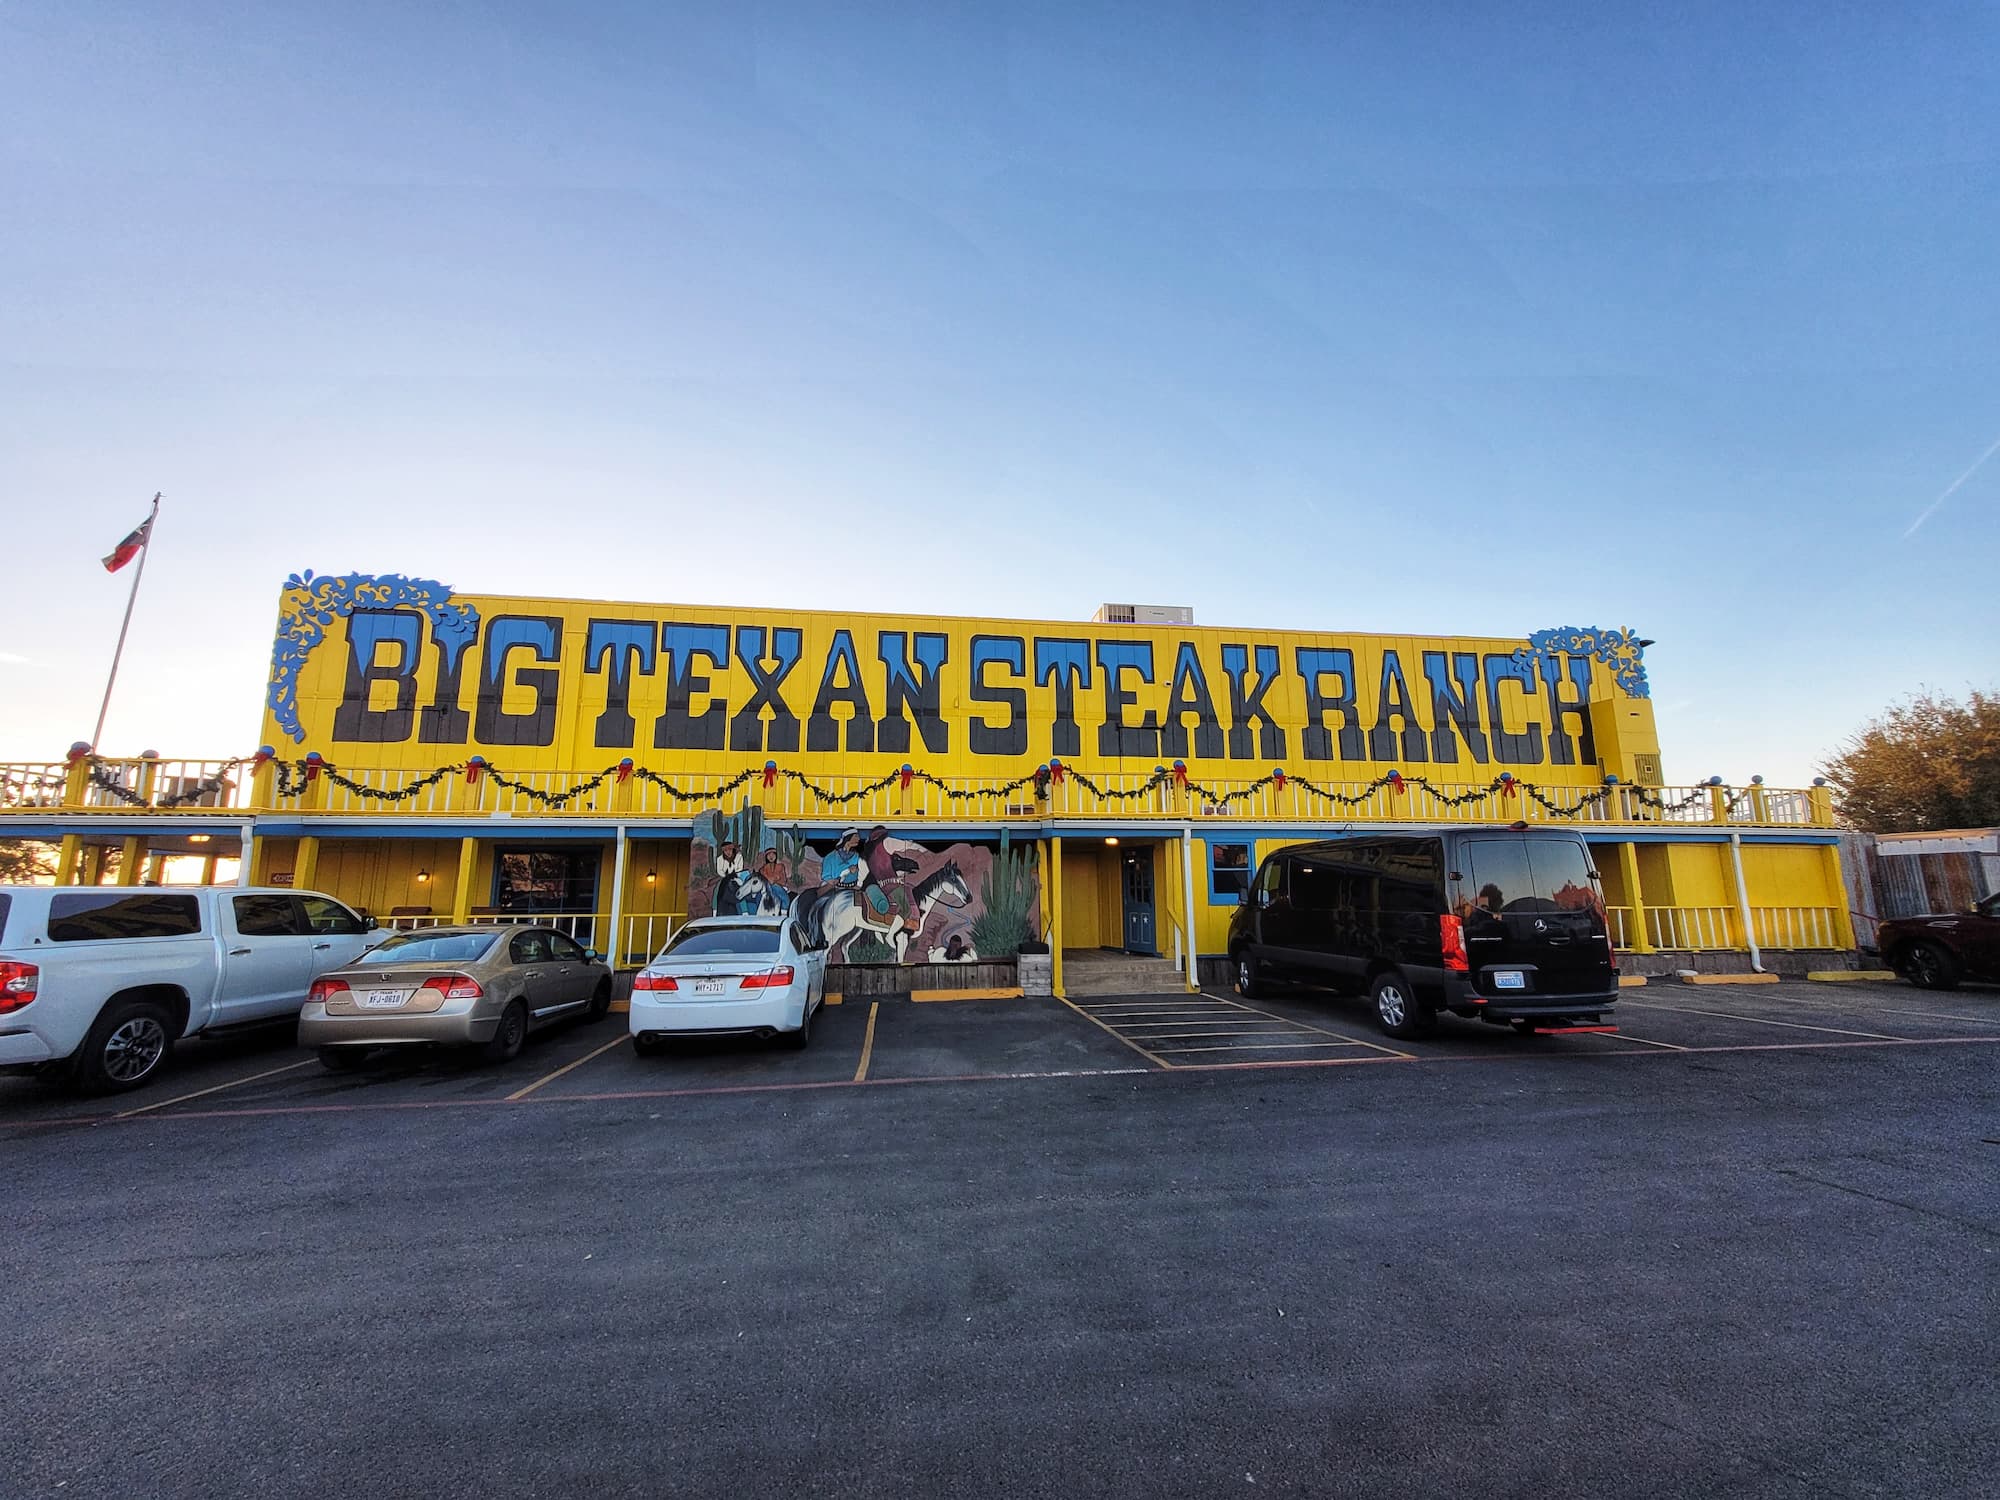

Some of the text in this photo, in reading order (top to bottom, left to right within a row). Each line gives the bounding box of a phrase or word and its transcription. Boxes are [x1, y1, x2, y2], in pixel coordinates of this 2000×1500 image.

[332, 606, 1598, 765] BIG TEXAN STEAK RANCH
